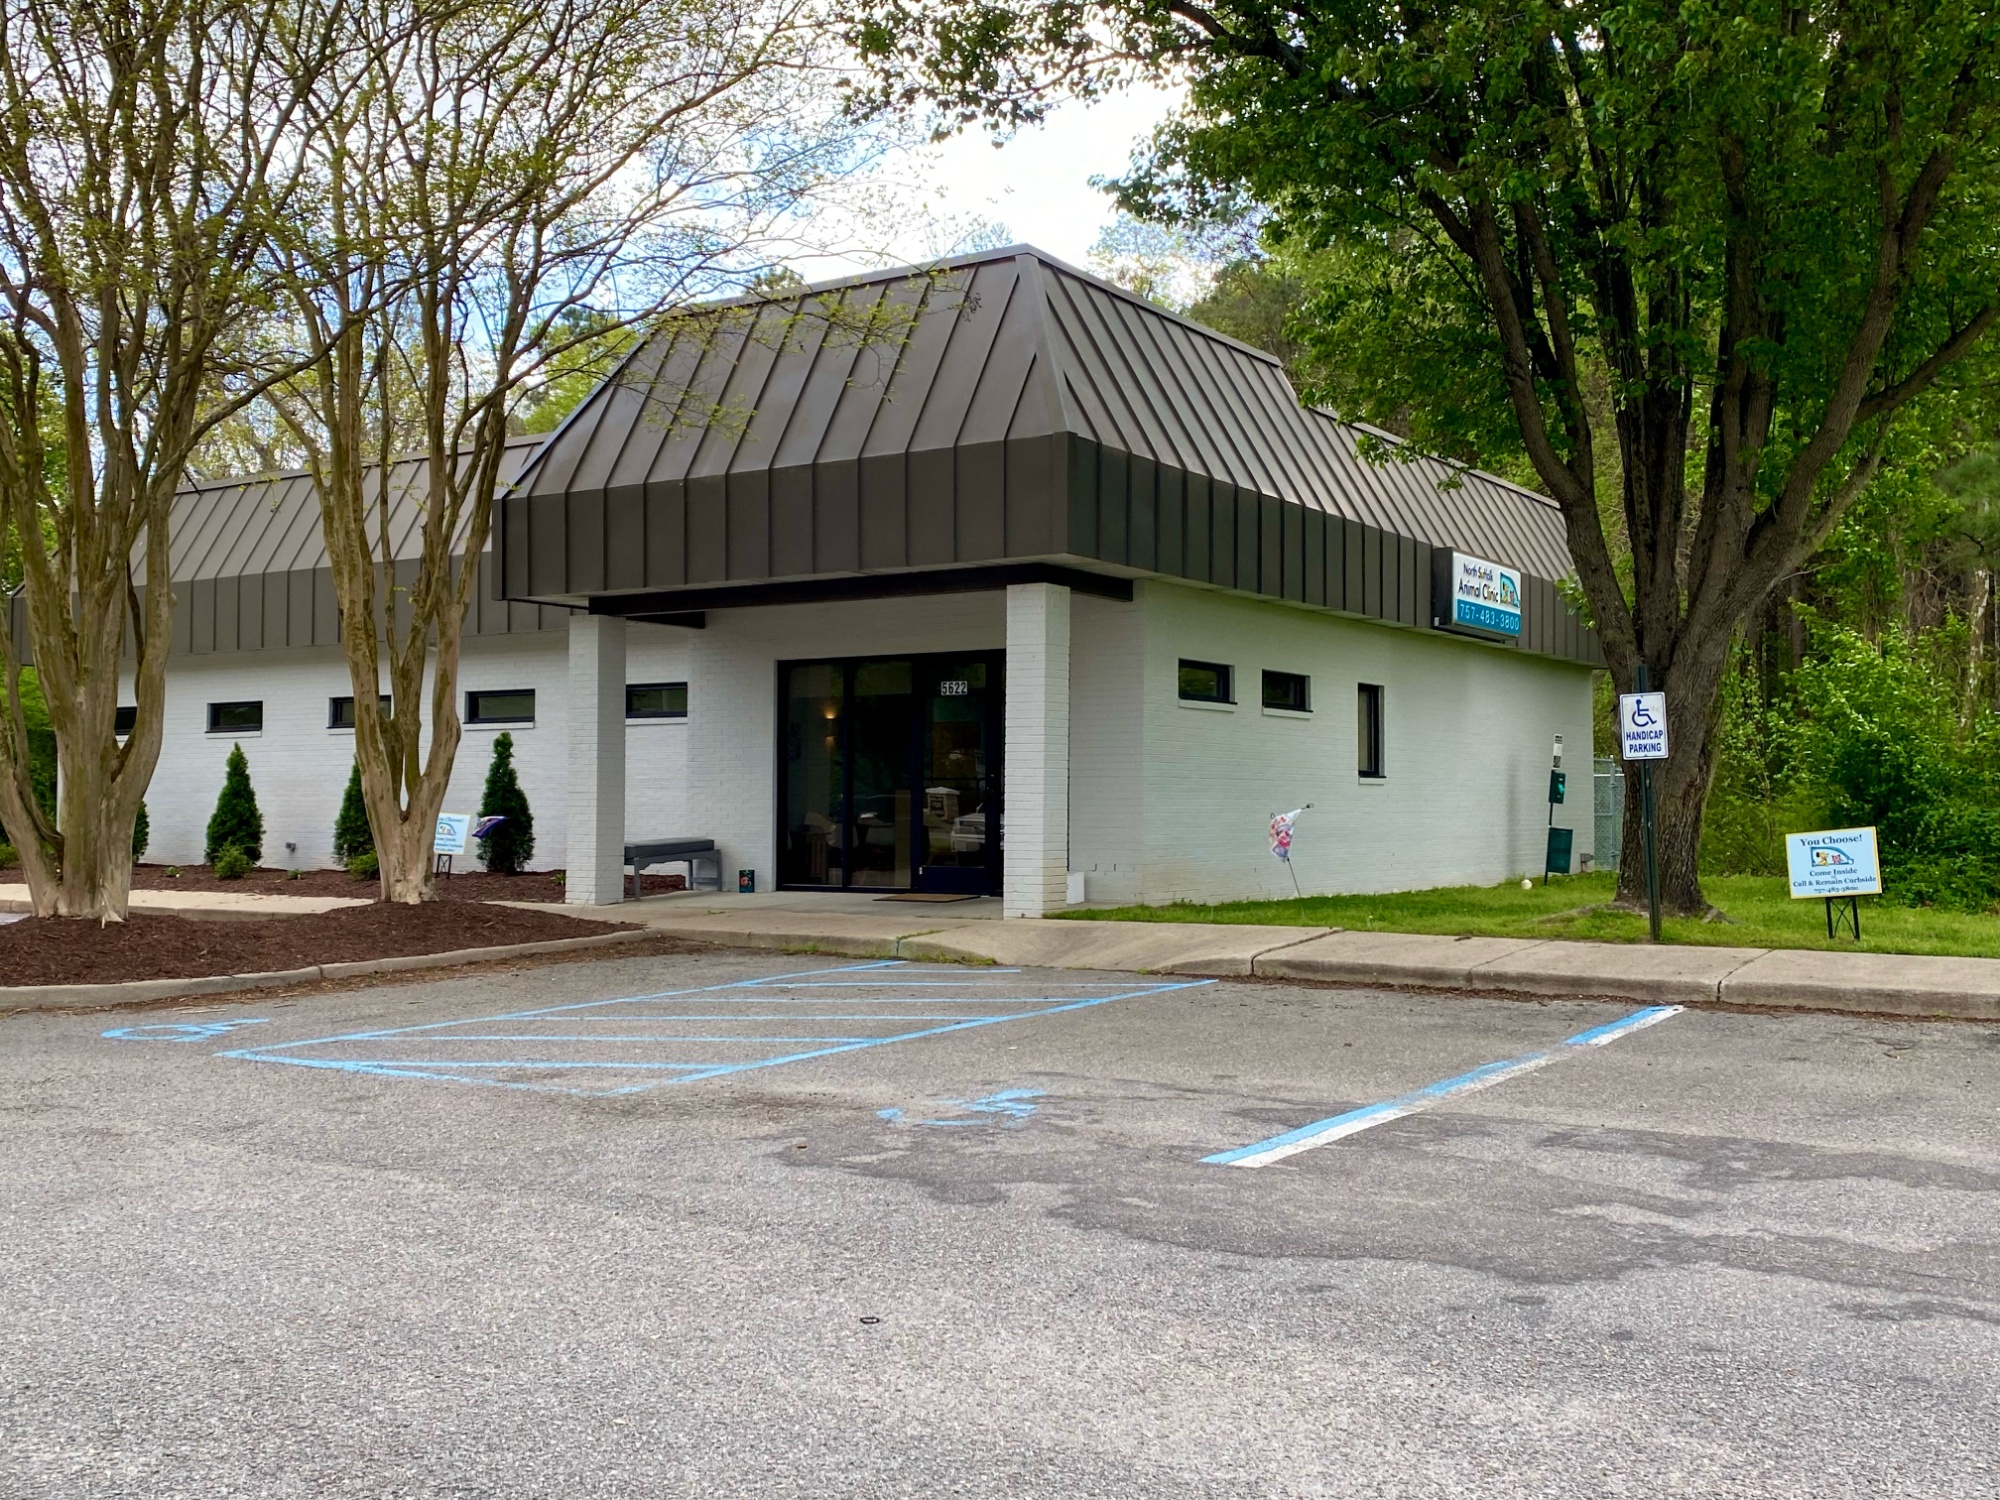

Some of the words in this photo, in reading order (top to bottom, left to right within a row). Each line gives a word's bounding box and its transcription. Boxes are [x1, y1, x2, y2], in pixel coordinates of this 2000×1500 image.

[1463, 562, 1477, 577] North
[1458, 578, 1481, 598] Animal
[1482, 583, 1499, 602] Clinic
[1460, 604, 1520, 631] 757-483-3800
[942, 682, 967, 695] 5622
[1626, 730, 1663, 741] HANDICAP
[1629, 743, 1662, 753] PARKING
[1800, 838, 1820, 847] You
[1822, 834, 1862, 845] Choose!
[1833, 867, 1857, 875] Inside
[1844, 876, 1876, 884] Curbside
